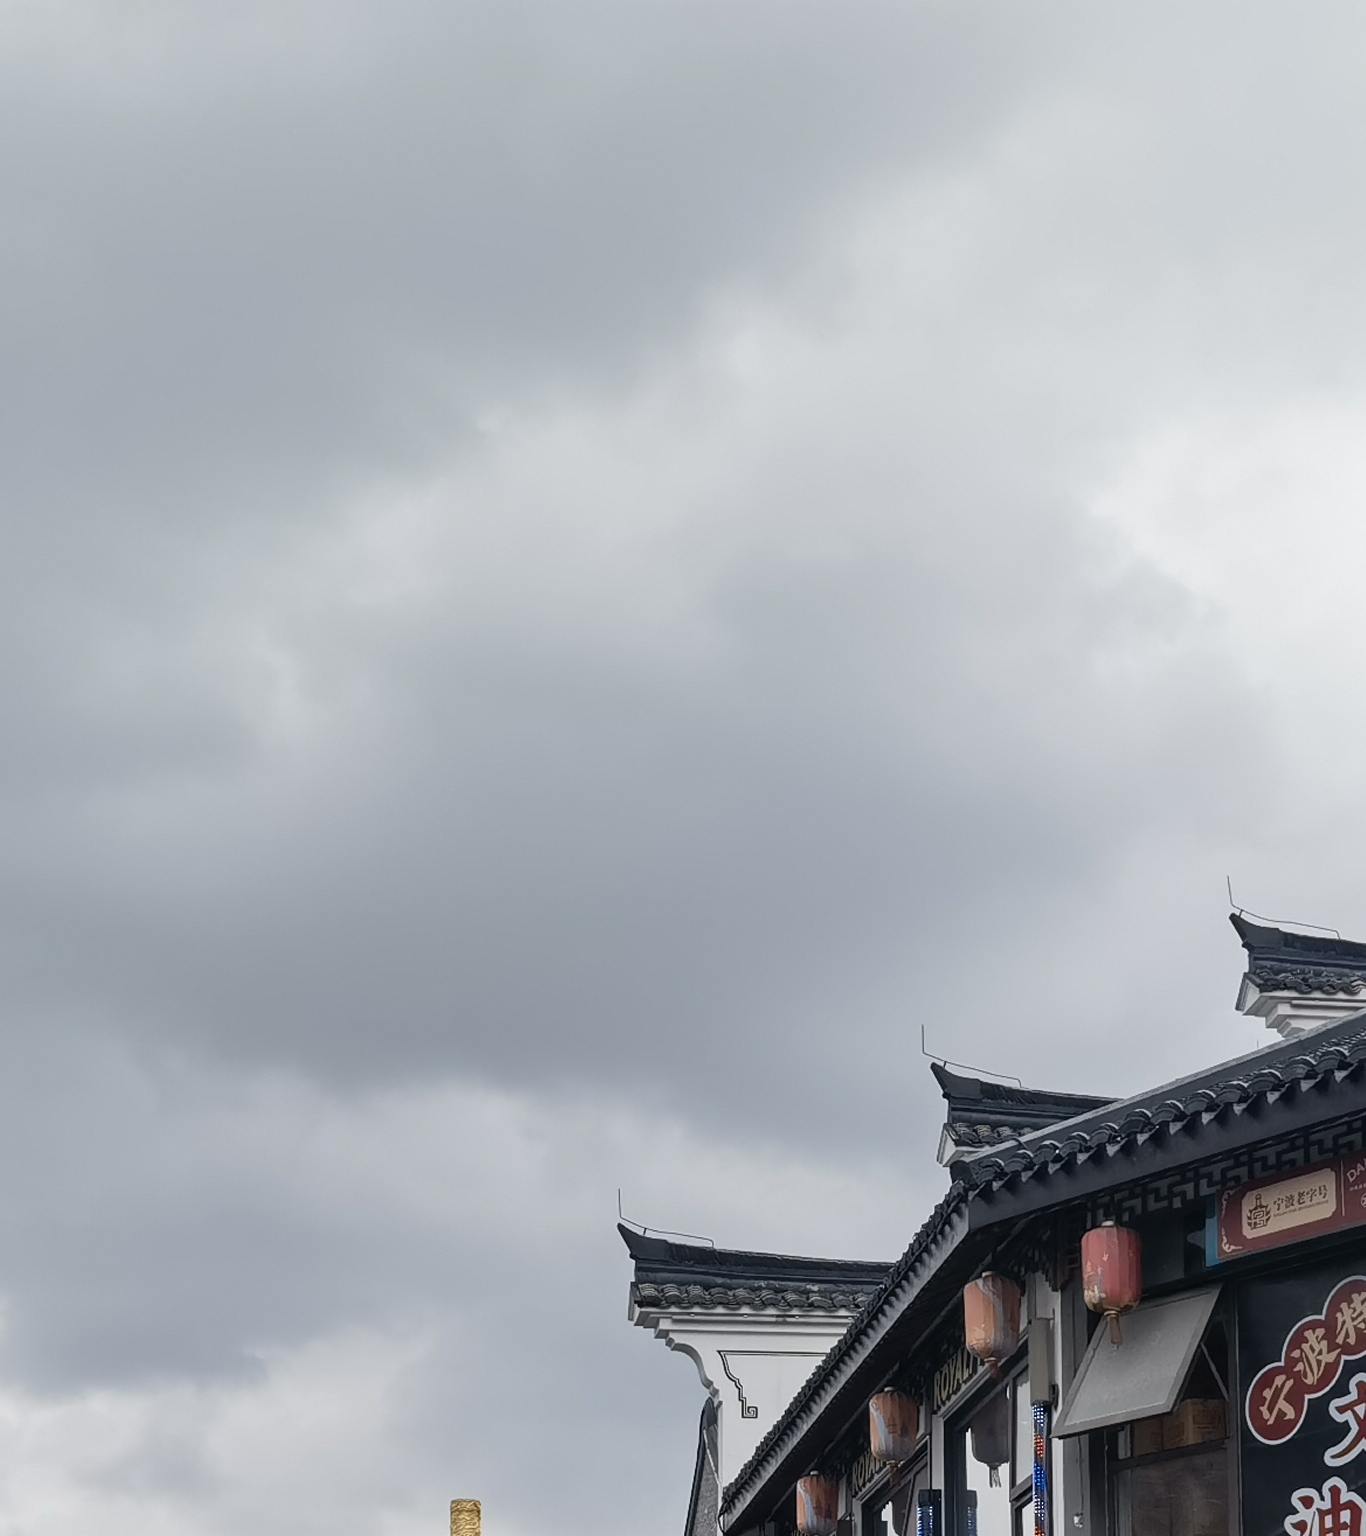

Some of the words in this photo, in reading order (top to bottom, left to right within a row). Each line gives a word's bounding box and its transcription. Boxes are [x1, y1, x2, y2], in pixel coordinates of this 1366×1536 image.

[1273, 1185, 1330, 1211] 宁波老字号
